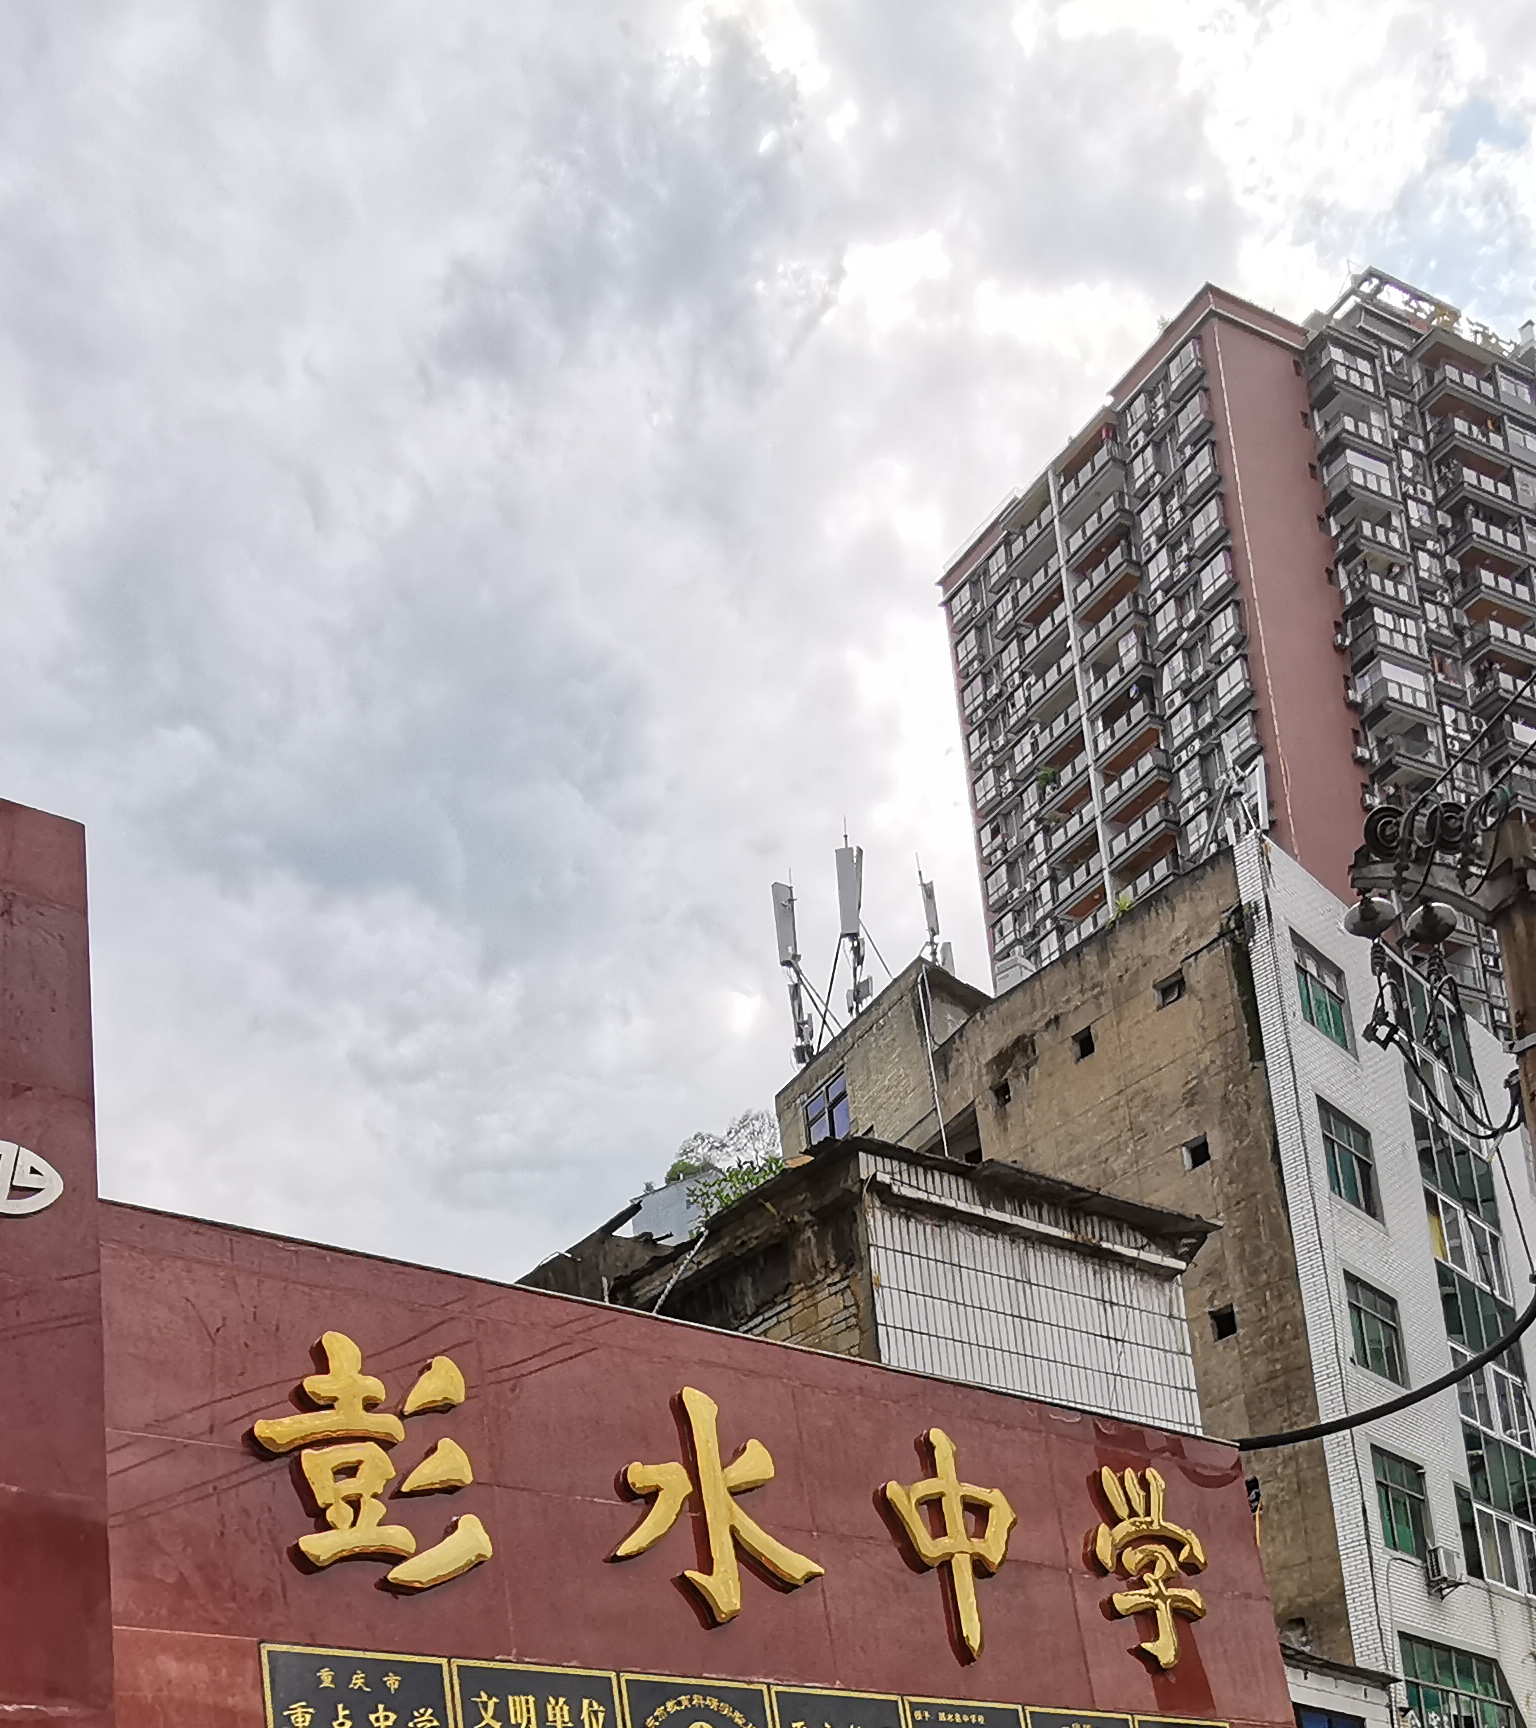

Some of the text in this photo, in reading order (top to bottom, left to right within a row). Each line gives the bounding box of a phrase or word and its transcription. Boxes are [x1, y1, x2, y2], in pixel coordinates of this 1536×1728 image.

[251, 1330, 1209, 1671] 彭水中学
[315, 1667, 403, 1695] 重庆市
